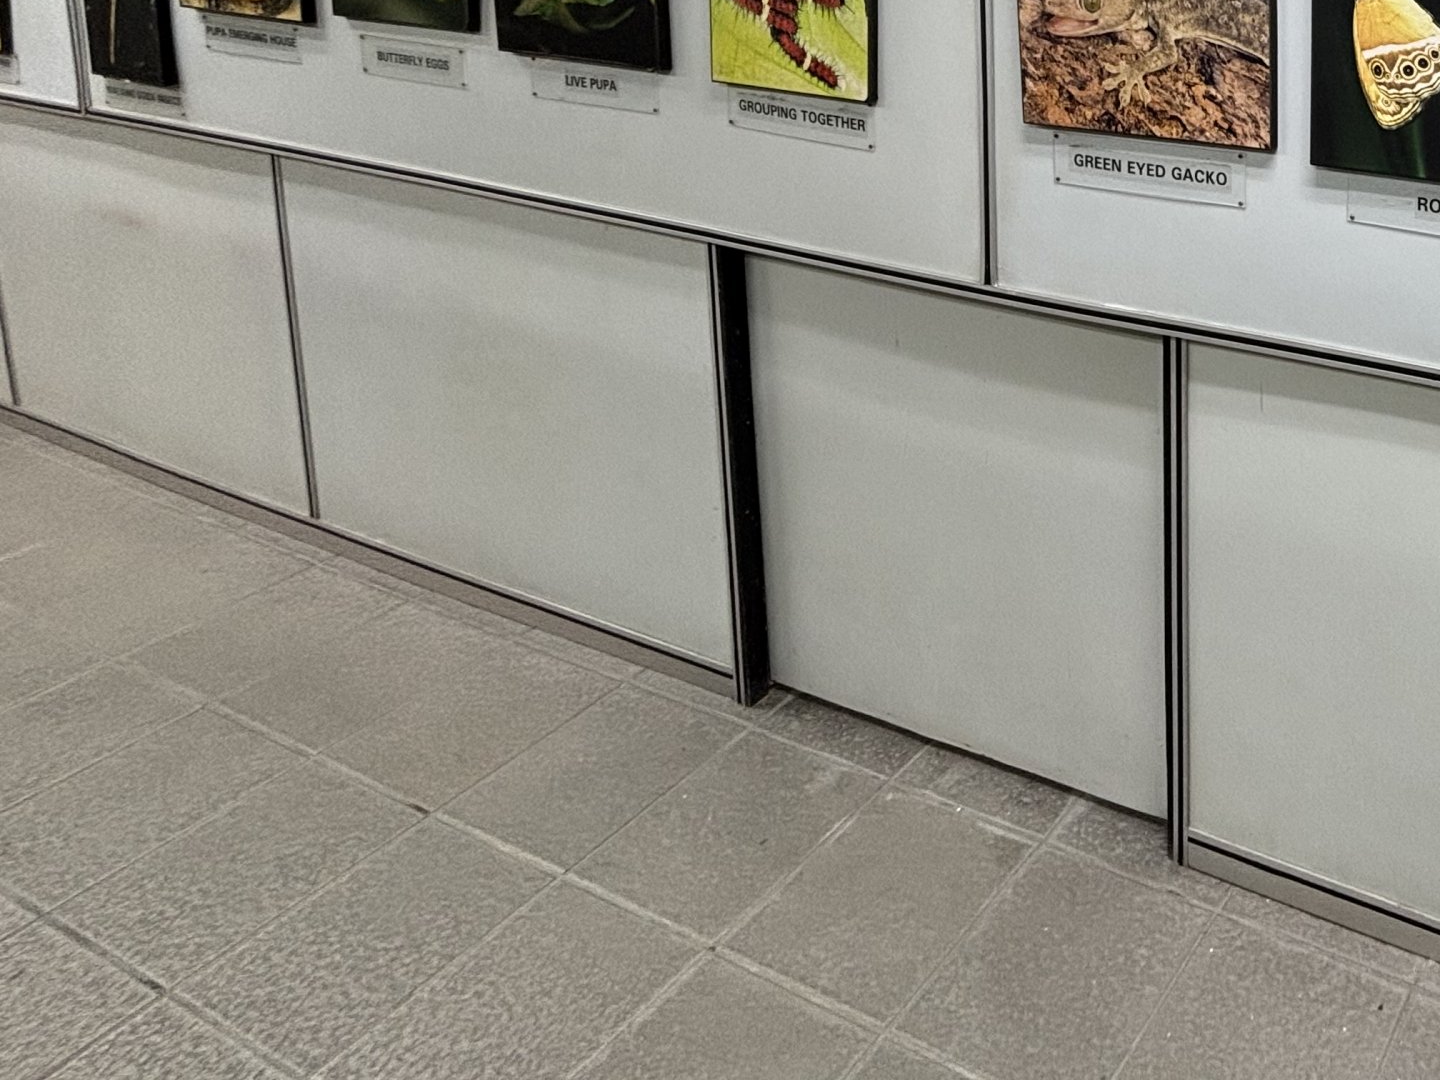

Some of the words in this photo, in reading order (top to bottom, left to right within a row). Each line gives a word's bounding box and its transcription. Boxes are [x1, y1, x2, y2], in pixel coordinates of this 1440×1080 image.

[376, 51, 423, 67] BUTTERFLY
[565, 75, 588, 89] LIVE
[590, 77, 617, 92] PUPA
[738, 99, 797, 121] GROUPING
[801, 109, 866, 132] TOGETHER
[1073, 153, 1122, 173] GREEN
[1126, 160, 1166, 179] EYED
[1170, 166, 1228, 187] GACKO
